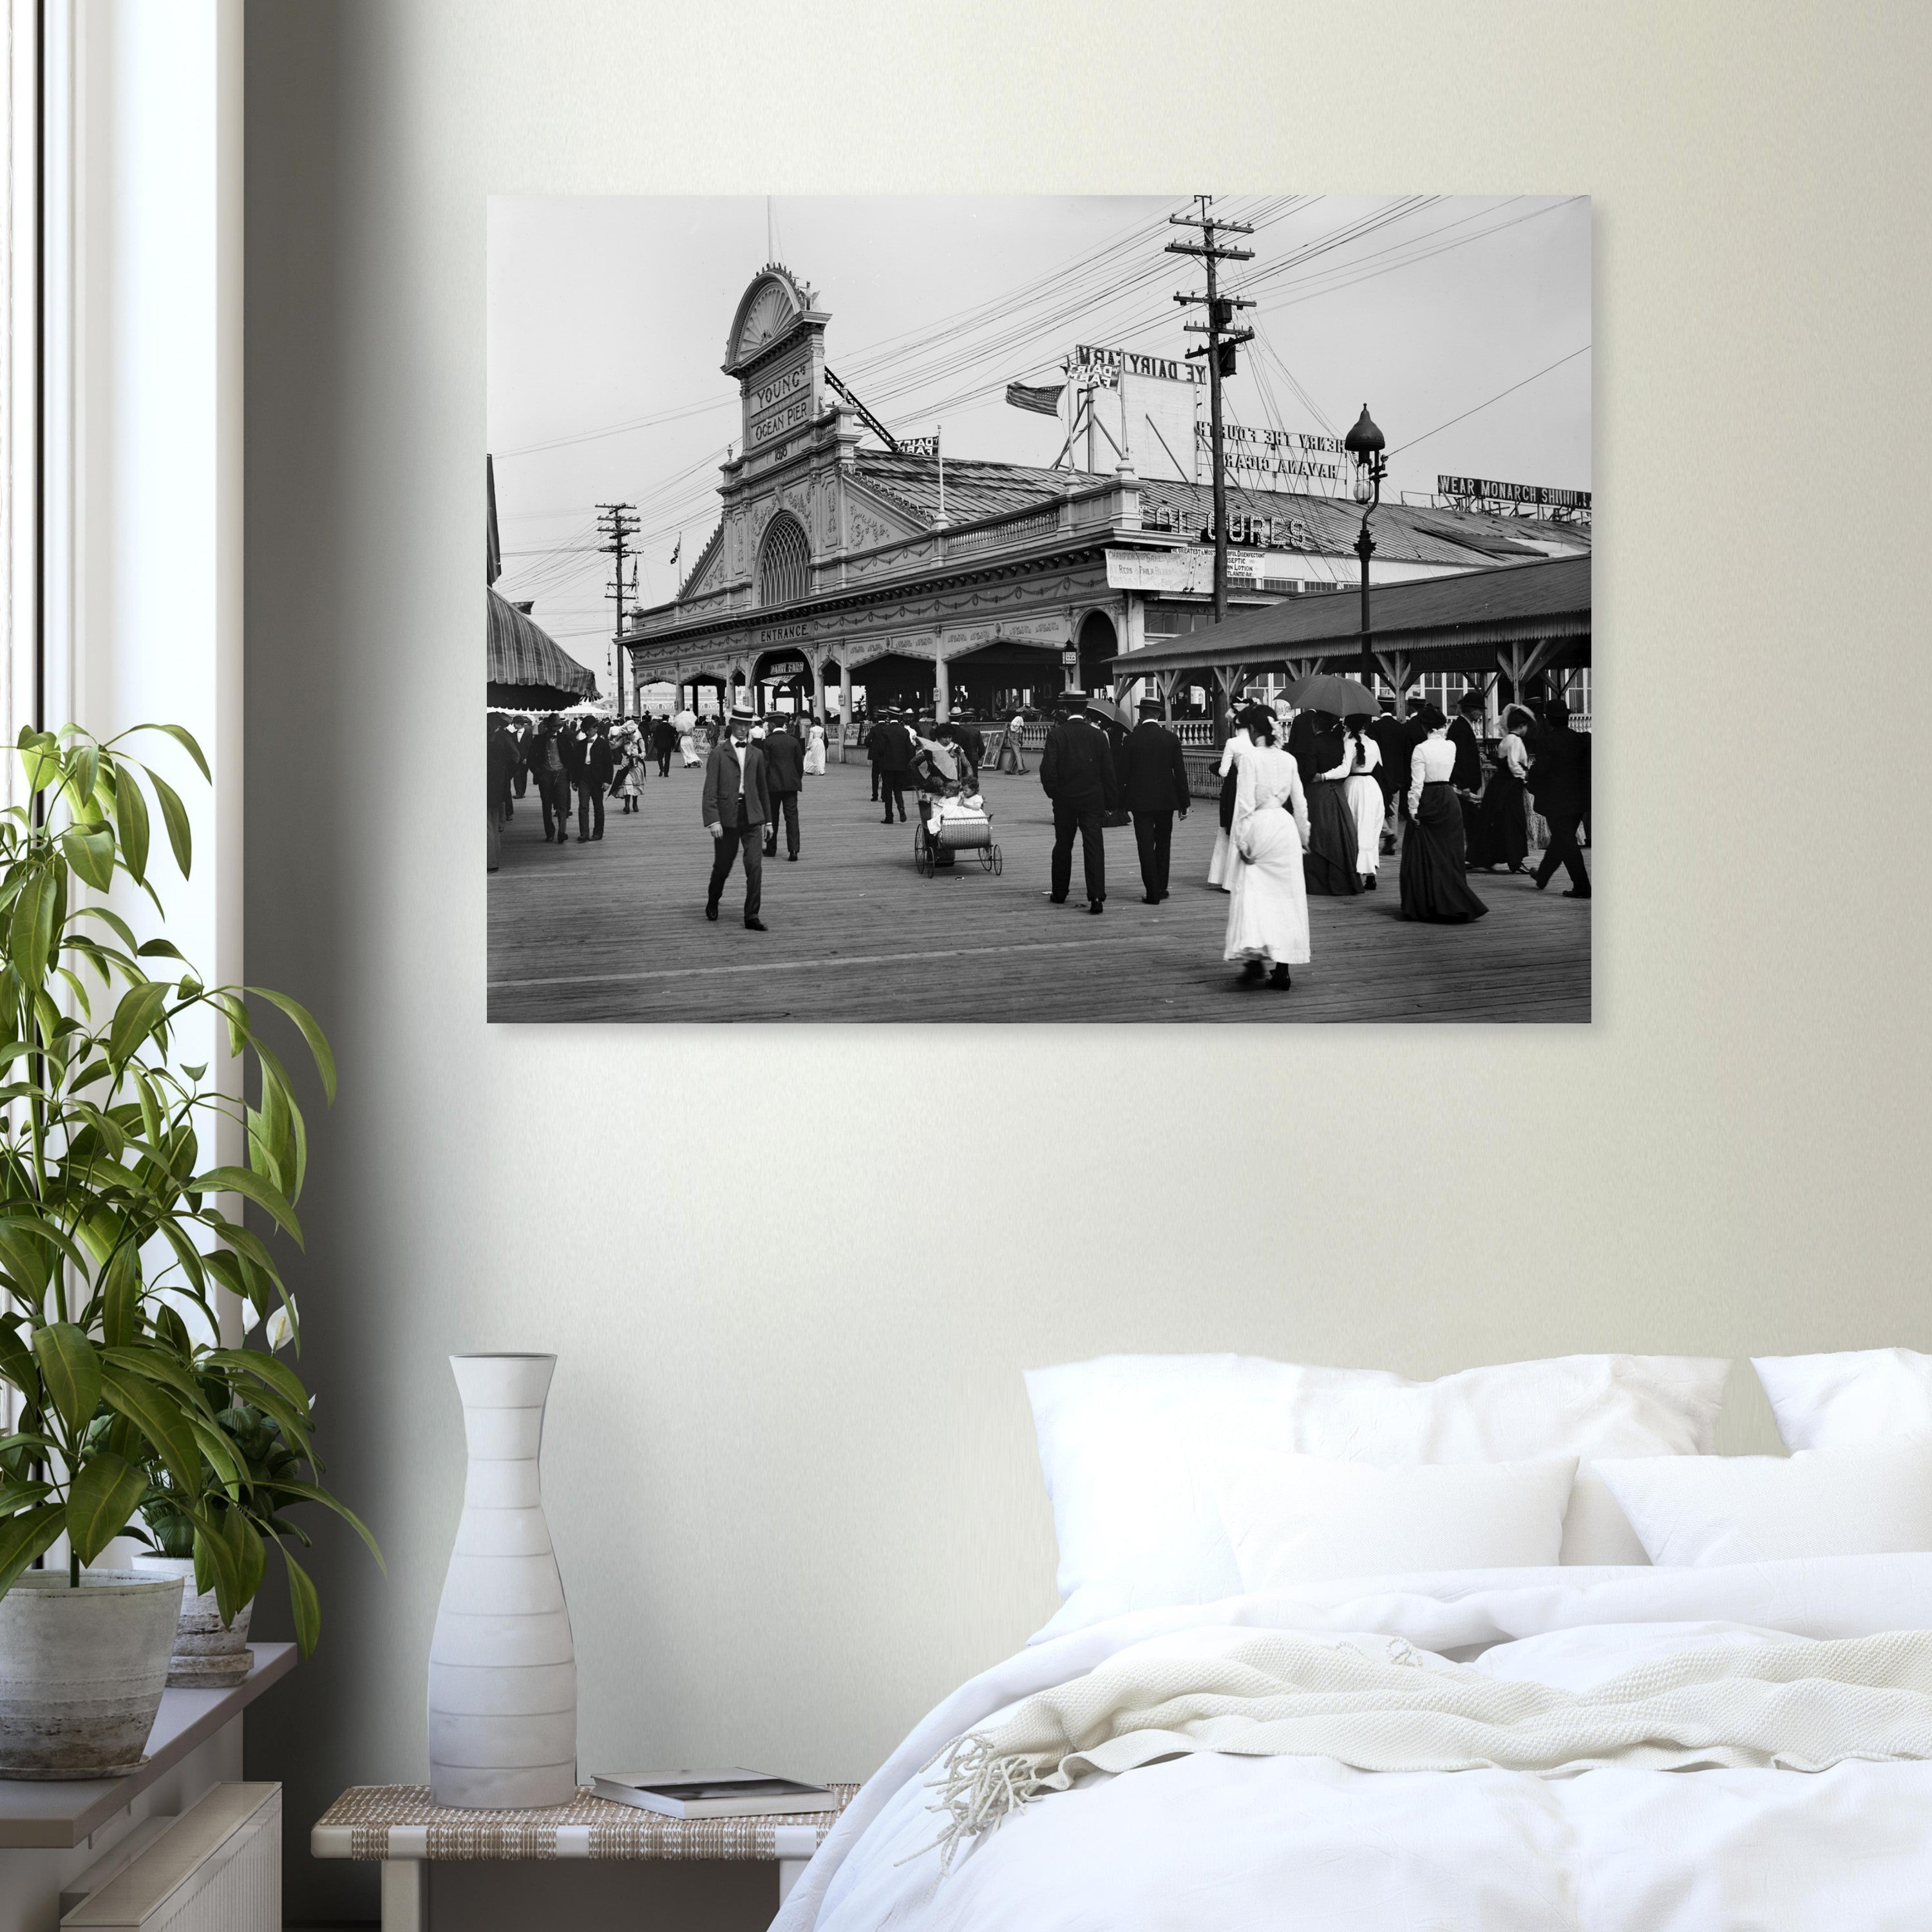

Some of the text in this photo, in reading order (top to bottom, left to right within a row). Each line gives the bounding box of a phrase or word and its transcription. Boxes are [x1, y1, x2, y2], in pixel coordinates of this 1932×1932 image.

[757, 365, 806, 408] YOUNG'S
[755, 402, 808, 440] OCEAN PIER
[1439, 475, 1475, 496] WEAR
[1481, 480, 1537, 502] MONARCH
[761, 624, 809, 642] ENTRANCE.
